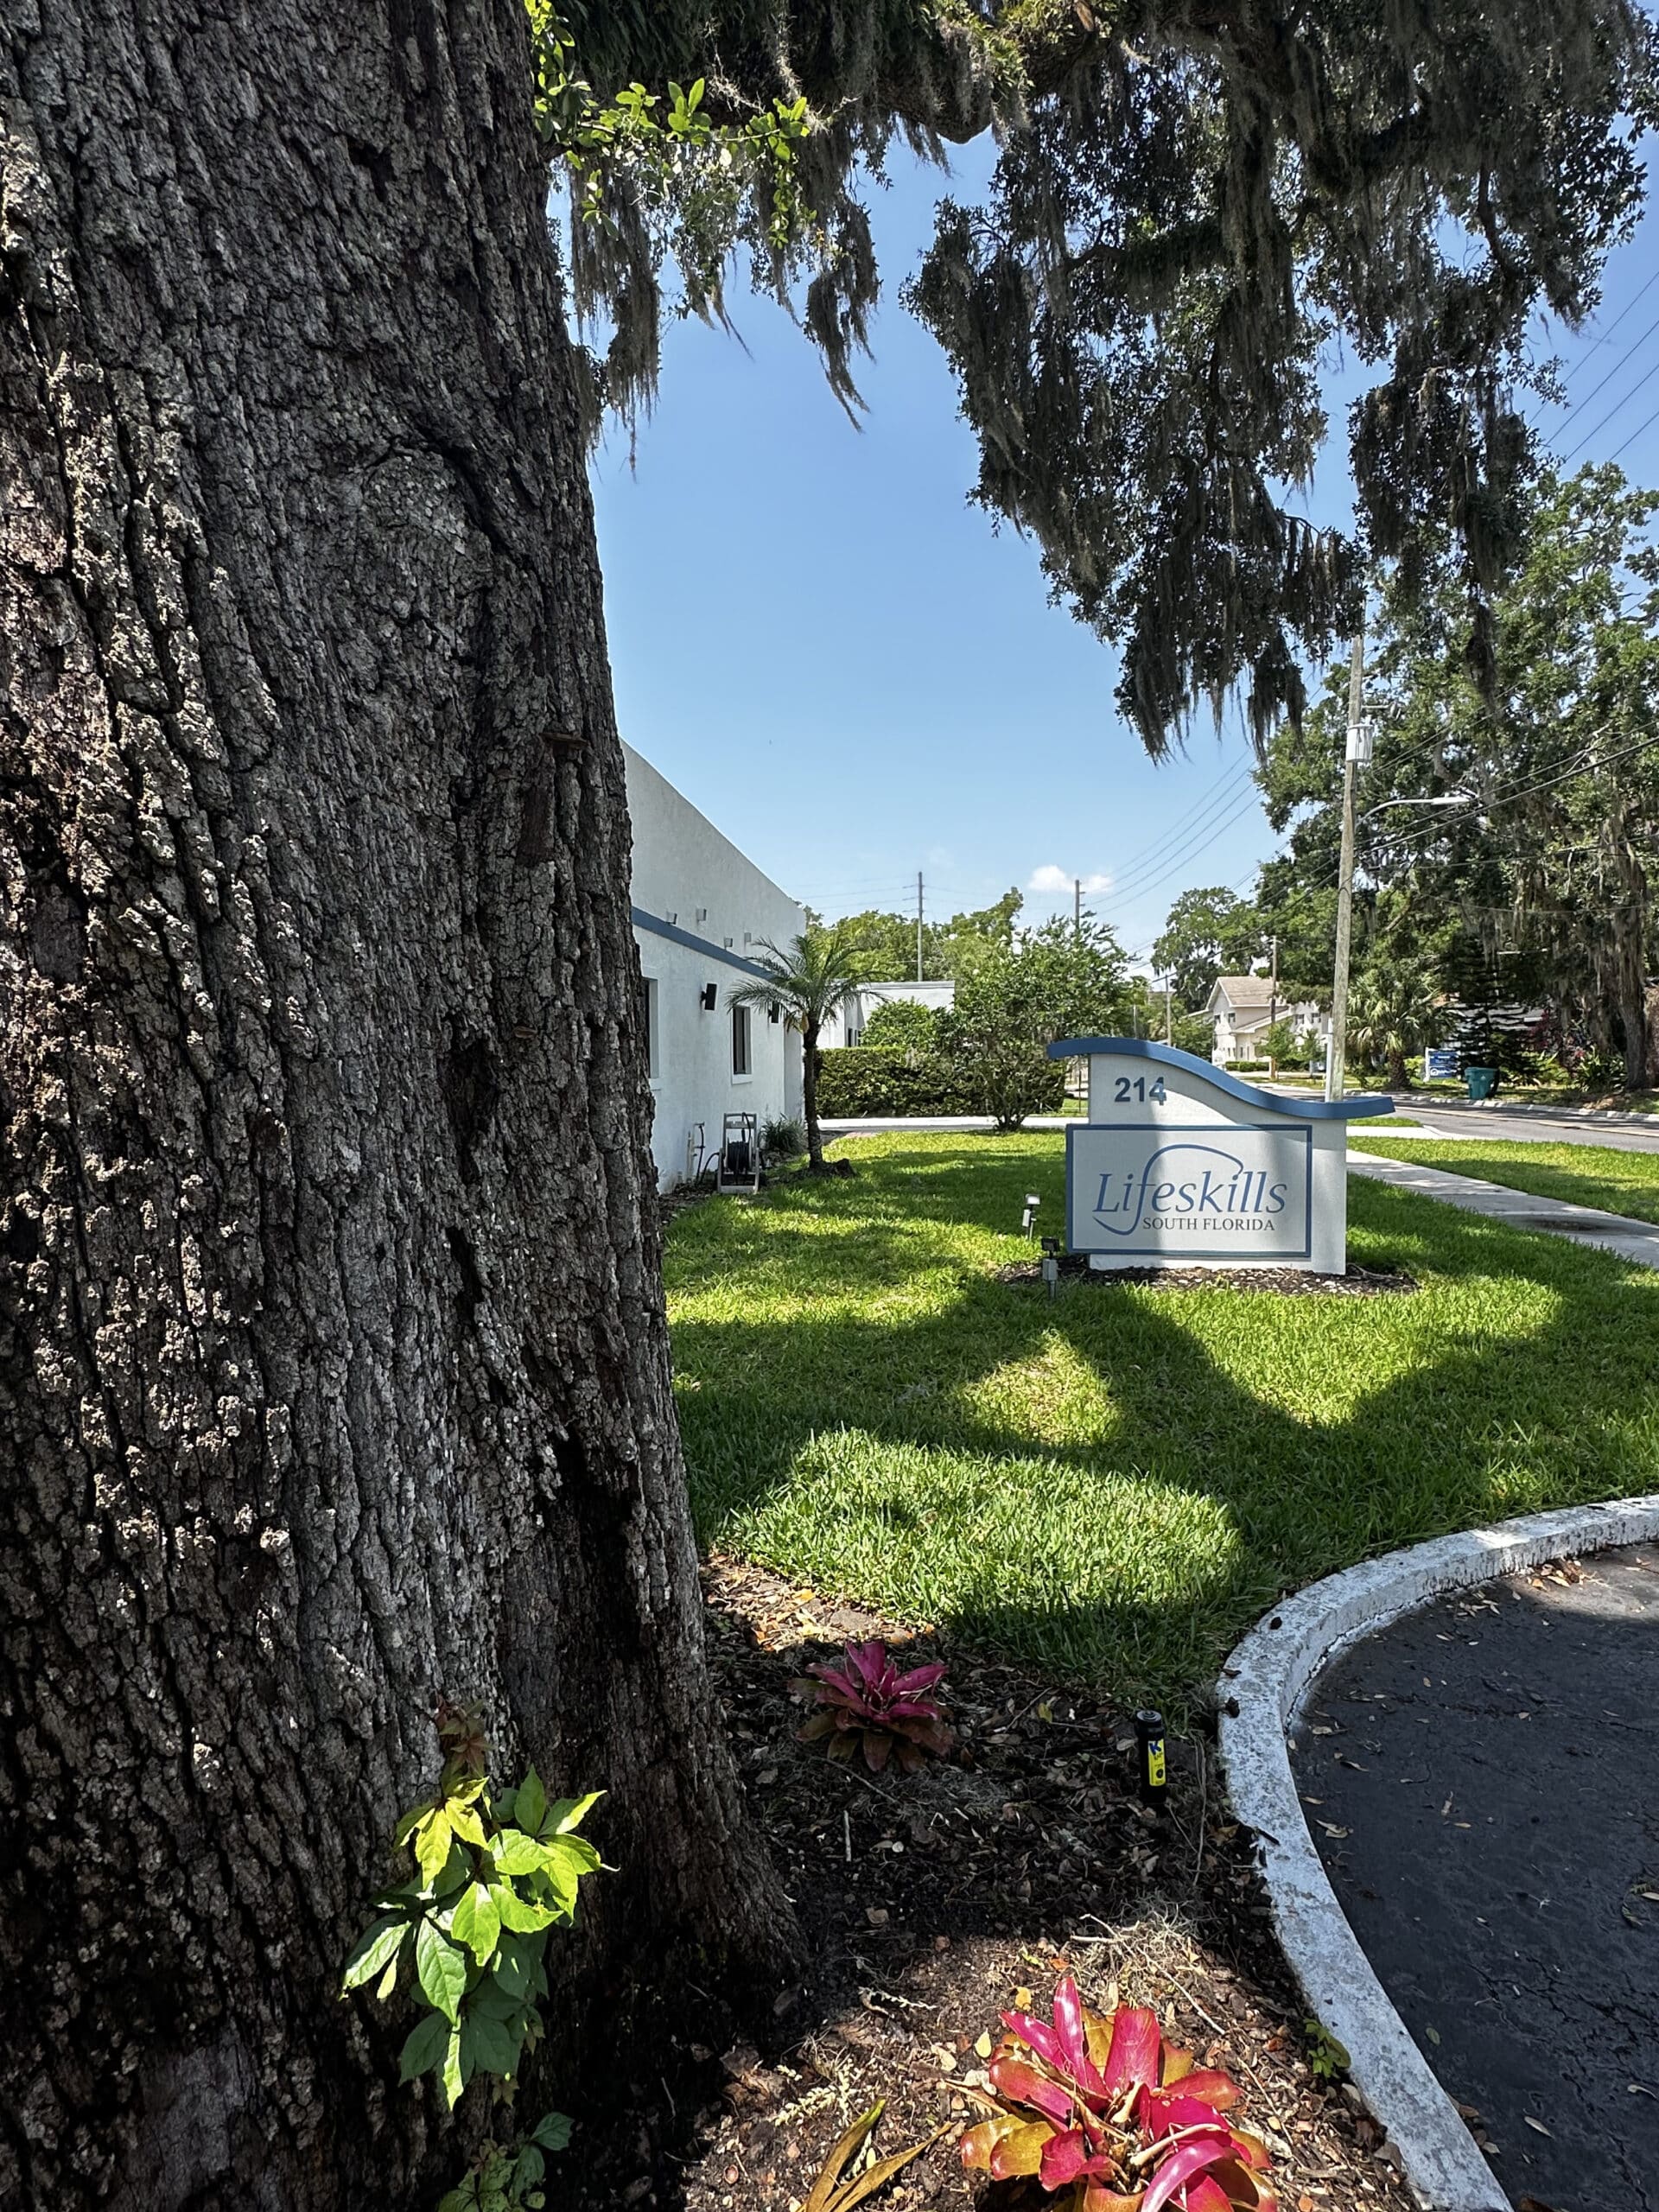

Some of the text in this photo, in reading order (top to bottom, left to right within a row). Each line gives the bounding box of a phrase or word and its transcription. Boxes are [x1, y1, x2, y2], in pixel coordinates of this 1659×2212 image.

[1114, 1077, 1166, 1105] 214
[1091, 1143, 1287, 1236] Lifeskills
[1142, 1217, 1275, 1231] SOUTH FLORIDA
